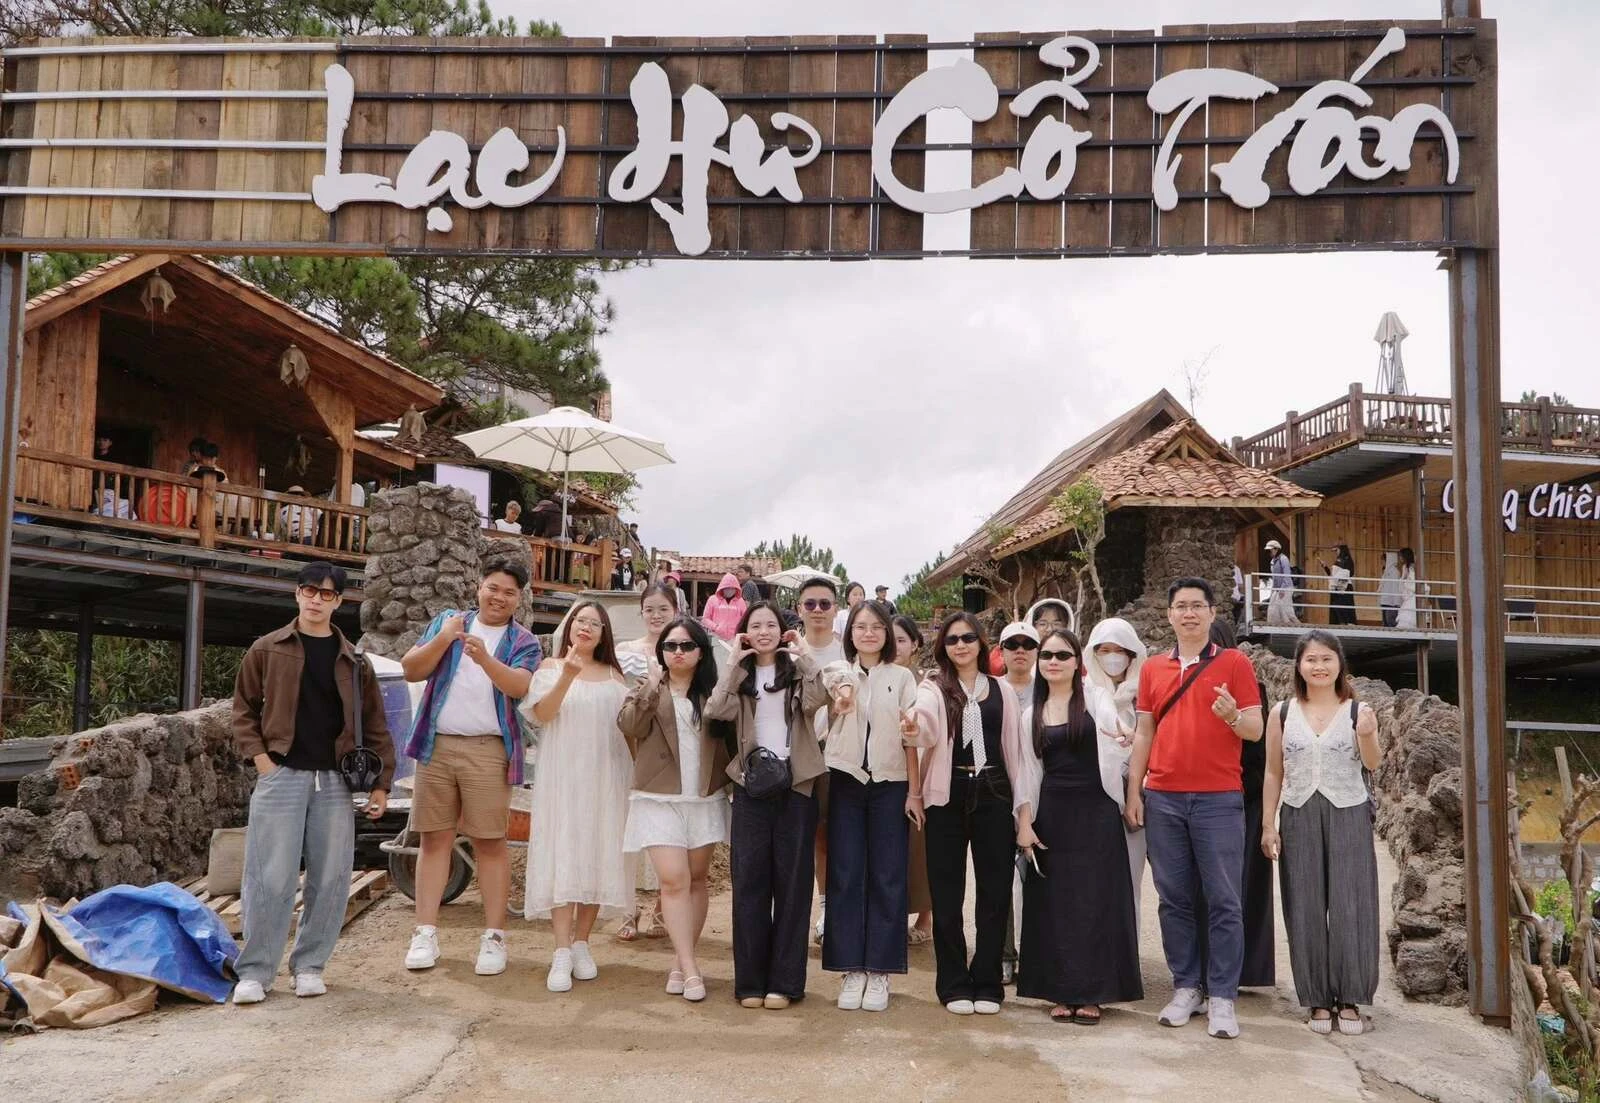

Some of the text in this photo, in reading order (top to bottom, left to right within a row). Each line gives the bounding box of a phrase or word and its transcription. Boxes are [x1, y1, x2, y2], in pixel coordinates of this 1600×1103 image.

[313, 63, 565, 233] Lạc
[608, 61, 822, 256] Hư
[873, 37, 1101, 213] Cổ
